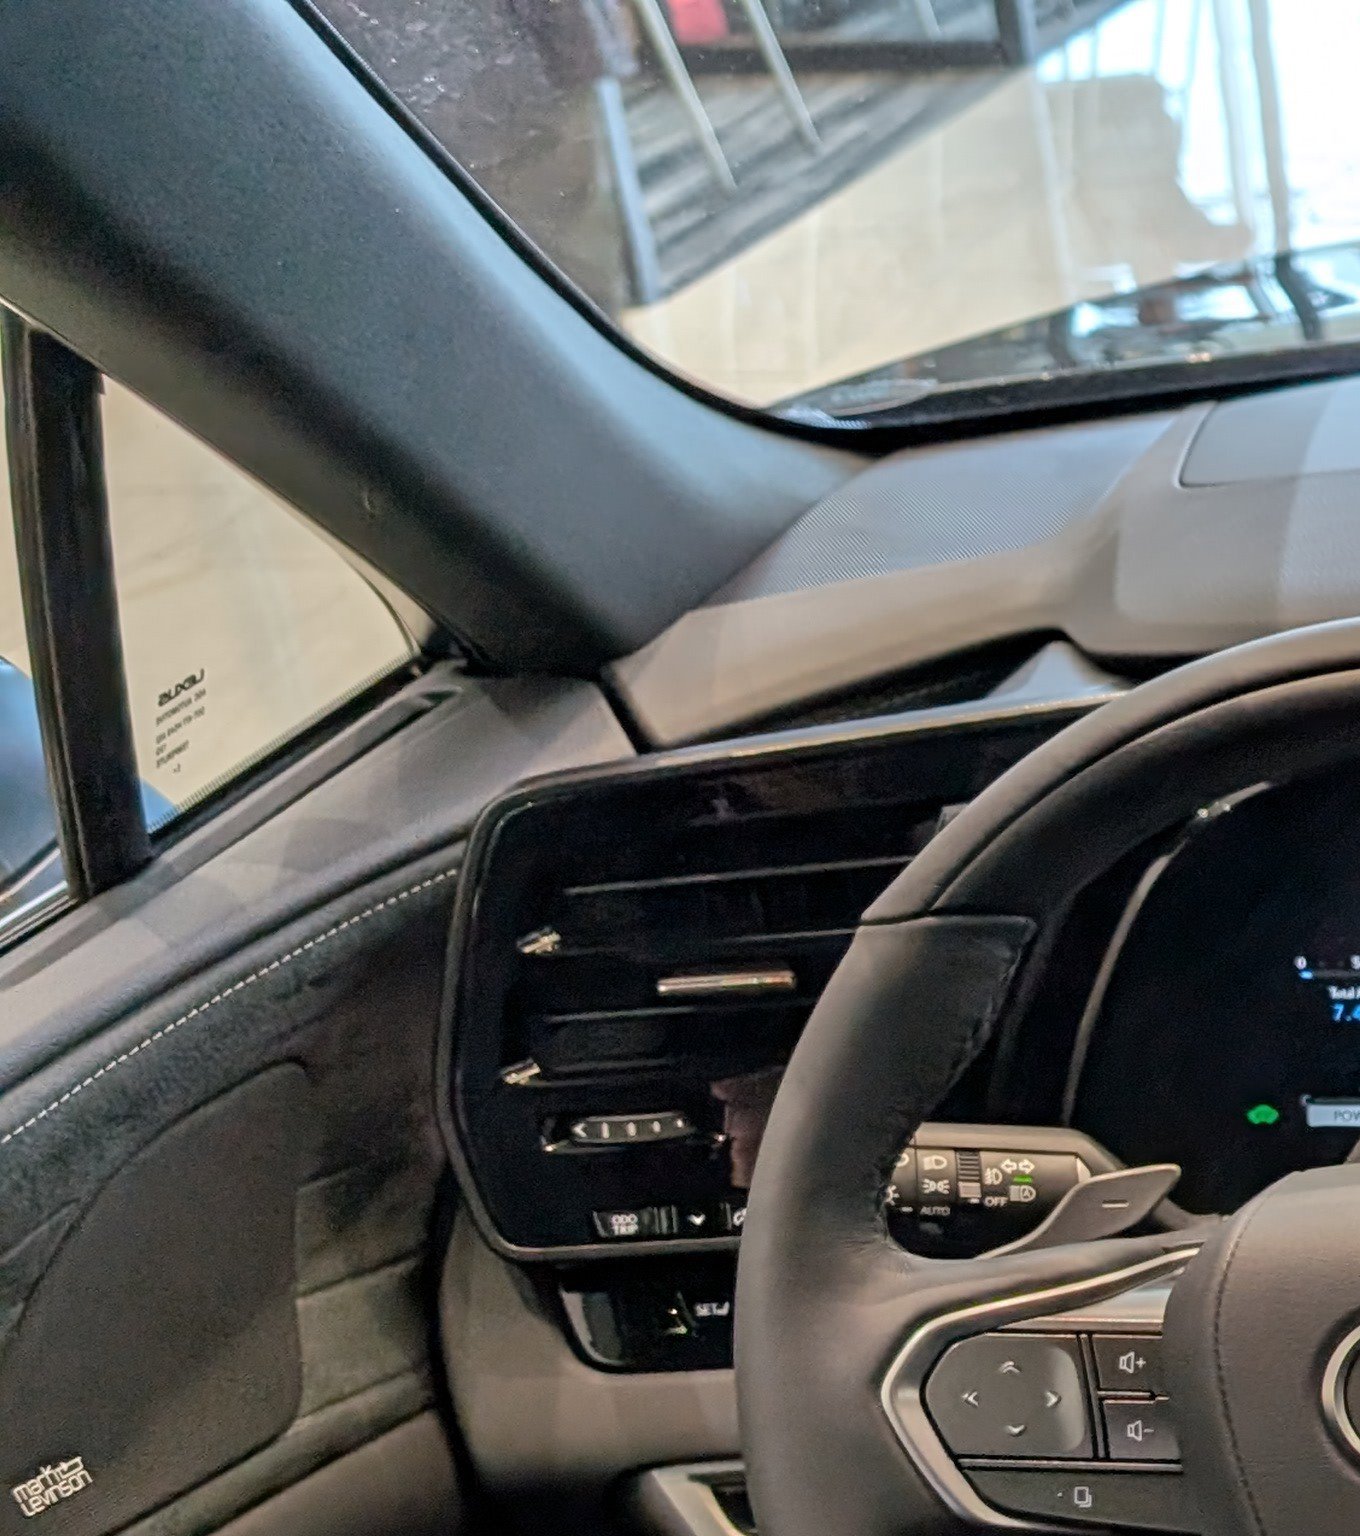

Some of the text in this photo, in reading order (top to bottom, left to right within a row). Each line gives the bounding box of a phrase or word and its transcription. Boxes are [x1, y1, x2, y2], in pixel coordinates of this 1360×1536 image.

[1294, 956, 1307, 970] 0
[1328, 985, 1356, 1000] Total
[984, 1196, 1008, 1208] OFF
[920, 1205, 951, 1217] AUTO
[611, 1213, 639, 1225] ODO
[613, 1224, 639, 1236] TRIP
